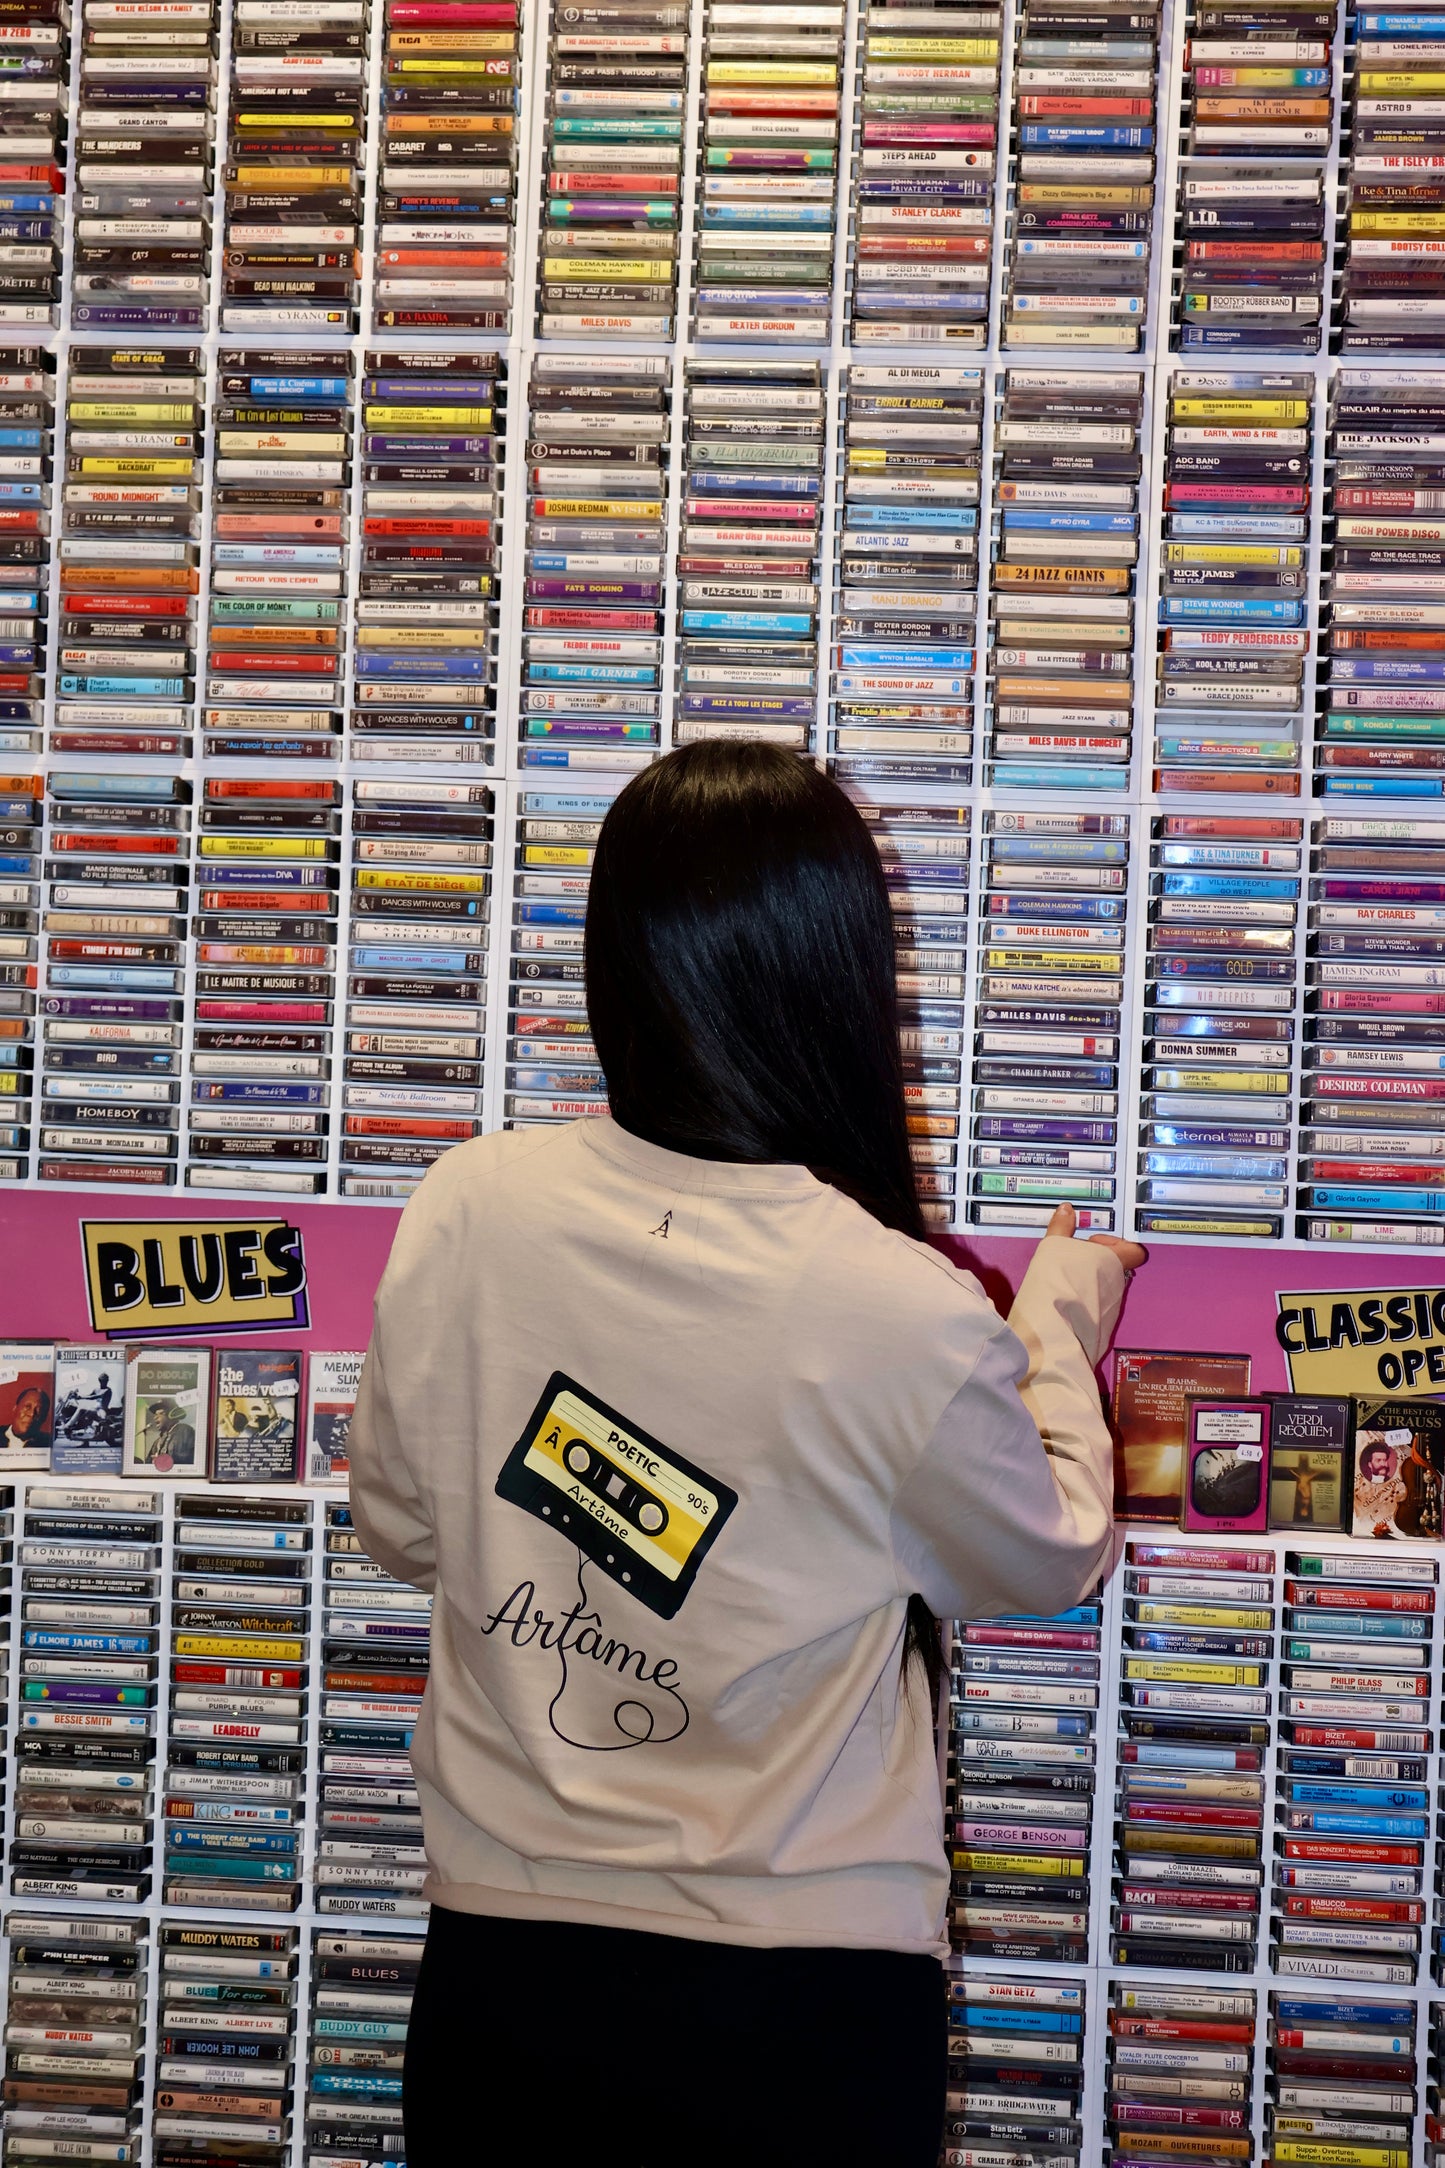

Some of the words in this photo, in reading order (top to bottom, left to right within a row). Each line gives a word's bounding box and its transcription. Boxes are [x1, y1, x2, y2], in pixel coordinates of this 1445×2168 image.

[897, 69, 930, 78] WOODY
[933, 69, 970, 78] HERMAN
[82, 141, 95, 149] THE
[97, 141, 142, 150] WANDERERS
[389, 143, 425, 151] CABARET
[882, 152, 905, 160] STEPS
[908, 152, 936, 160] AHEAD
[1360, 187, 1375, 195] Ike
[1376, 187, 1384, 195] &
[1385, 186, 1407, 195] Tina
[1408, 185, 1440, 195] Turner
[892, 208, 928, 217] STANLEY
[930, 209, 962, 217] CLARKE
[1189, 211, 1220, 225] L.T.D.
[1213, 296, 1245, 306] BOOTSY'S
[1246, 296, 1270, 308] RUBBER
[1271, 296, 1289, 308] BAND
[278, 310, 326, 320] CYRANO
[581, 318, 606, 327] MILES
[608, 318, 632, 327] DAVIS
[730, 321, 761, 330] DEXTER
[763, 322, 795, 331] GORDON
[111, 354, 130, 362] STATE
[143, 355, 165, 363] GRACE
[888, 368, 898, 378] AL
[900, 368, 910, 378] DI
[911, 368, 940, 378] MEOLA
[1203, 429, 1229, 438] EARTH,
[1232, 429, 1250, 438] WIND
[1252, 430, 1259, 438] &
[1261, 430, 1278, 438] FIRE
[1340, 435, 1364, 443] THE
[118, 463, 154, 472] BACKDRAFT
[548, 503, 576, 513] JOSHUA
[577, 503, 609, 514] REDMAN
[1352, 526, 1373, 535] HIGH
[1376, 527, 1410, 538] POWER
[1411, 528, 1440, 538] DISCO
[856, 536, 889, 547] ATLANTIC
[893, 535, 909, 547] JAZZ
[1015, 569, 1030, 581] 24
[1034, 569, 1060, 582] JAZZ
[1063, 569, 1105, 582] GIANTS
[1173, 570, 1200, 579] RICK
[1201, 570, 1236, 579] JAMES
[565, 585, 585, 593] FATS
[589, 585, 623, 593] DOMINO
[218, 603, 230, 611] THE
[233, 602, 254, 611] COLOR
[256, 603, 264, 611] OF
[267, 602, 292, 611] MONEY
[1201, 633, 1229, 644] TEDDY
[1232, 634, 1299, 645] PENDERGRASS
[558, 667, 587, 677] Erroll
[591, 667, 638, 679] GARNER
[863, 679, 878, 688] THE
[878, 679, 903, 689] SOUND
[905, 680, 915, 689] OF
[915, 680, 934, 689] JAZZ
[378, 715, 409, 724] DANCES
[409, 716, 427, 724] WITH
[427, 716, 458, 725] WOLVES
[1029, 737, 1050, 746] MILES
[1052, 737, 1076, 747] DAVIS
[1078, 738, 1086, 747] IN
[1088, 738, 1122, 748] CONCERT
[385, 878, 413, 890] ÉTAT
[416, 879, 429, 889] DE
[1358, 910, 1375, 919] RAY
[1378, 910, 1415, 920] CHARLES
[1017, 926, 1040, 936] DUKE
[1042, 927, 1089, 937] ELLINGTON
[211, 977, 219, 987] LE
[222, 977, 248, 988] MAITRE
[250, 977, 260, 988] DE
[263, 977, 297, 988] MUSIQUE
[1000, 1010, 1031, 1020] MILES
[1034, 1012, 1066, 1021] DAVIS
[90, 1027, 130, 1038] KALIFORNIA
[1161, 1045, 1192, 1055] DONNA
[1196, 1045, 1237, 1056] SUMMER
[1348, 1051, 1378, 1060] RAMSEY
[1380, 1051, 1404, 1061] LEWIS
[96, 1053, 117, 1064] BIRD
[1010, 1068, 1041, 1078] CHARLIE
[1043, 1069, 1071, 1078] PARKER
[1319, 1079, 1368, 1093] DESIREE
[1371, 1081, 1426, 1095] COLEMAN
[76, 1106, 140, 1119] HOMEBOY
[1175, 1130, 1224, 1142] eternal
[97, 1227, 307, 1312] BLUES
[220, 1368, 243, 1381] the
[220, 1382, 257, 1396] blues
[1151, 1384, 1183, 1392] REQUIEM
[1184, 1386, 1224, 1394] ALLEMAND
[1383, 1407, 1403, 1415] THE
[1288, 1414, 1323, 1425] VERDI
[1378, 1416, 1442, 1428] STRAUSS
[1279, 1425, 1333, 1437] REQUIEM
[544, 1426, 561, 1449] Â
[607, 1431, 660, 1478] POETIC
[687, 1493, 709, 1515] 90's
[568, 1484, 628, 1540] Artâme
[481, 1580, 680, 1691] Artâme
[39, 1636, 69, 1647] ELMORE
[71, 1637, 104, 1649] JAMES
[108, 1639, 117, 1651] 16
[1330, 1677, 1355, 1687] PHILIP
[1356, 1678, 1383, 1688] GLASS
[54, 1715, 83, 1726] BESSIE
[86, 1715, 112, 1726] SMITH
[213, 1724, 260, 1736] LEADBELLY
[189, 1777, 214, 1785] JIMMY
[217, 1779, 269, 1788] WITHERSPOON
[974, 1828, 1019, 1839] GEORGE
[1022, 1830, 1067, 1843] BENSON
[1125, 1891, 1156, 1904] BACH
[329, 1899, 361, 1911] MUDDY
[363, 1900, 396, 1912] WATERS
[180, 1932, 219, 1946] MUDDY
[221, 1934, 260, 1948] WATERS
[351, 1967, 399, 1979] BLUES
[1287, 1960, 1338, 1975] VIVALDI
[169, 2016, 199, 2024] ALBERT
[224, 2019, 253, 2027] ALBERT
[320, 2021, 360, 2033] BUDDY
[363, 2024, 389, 2034] GUY
